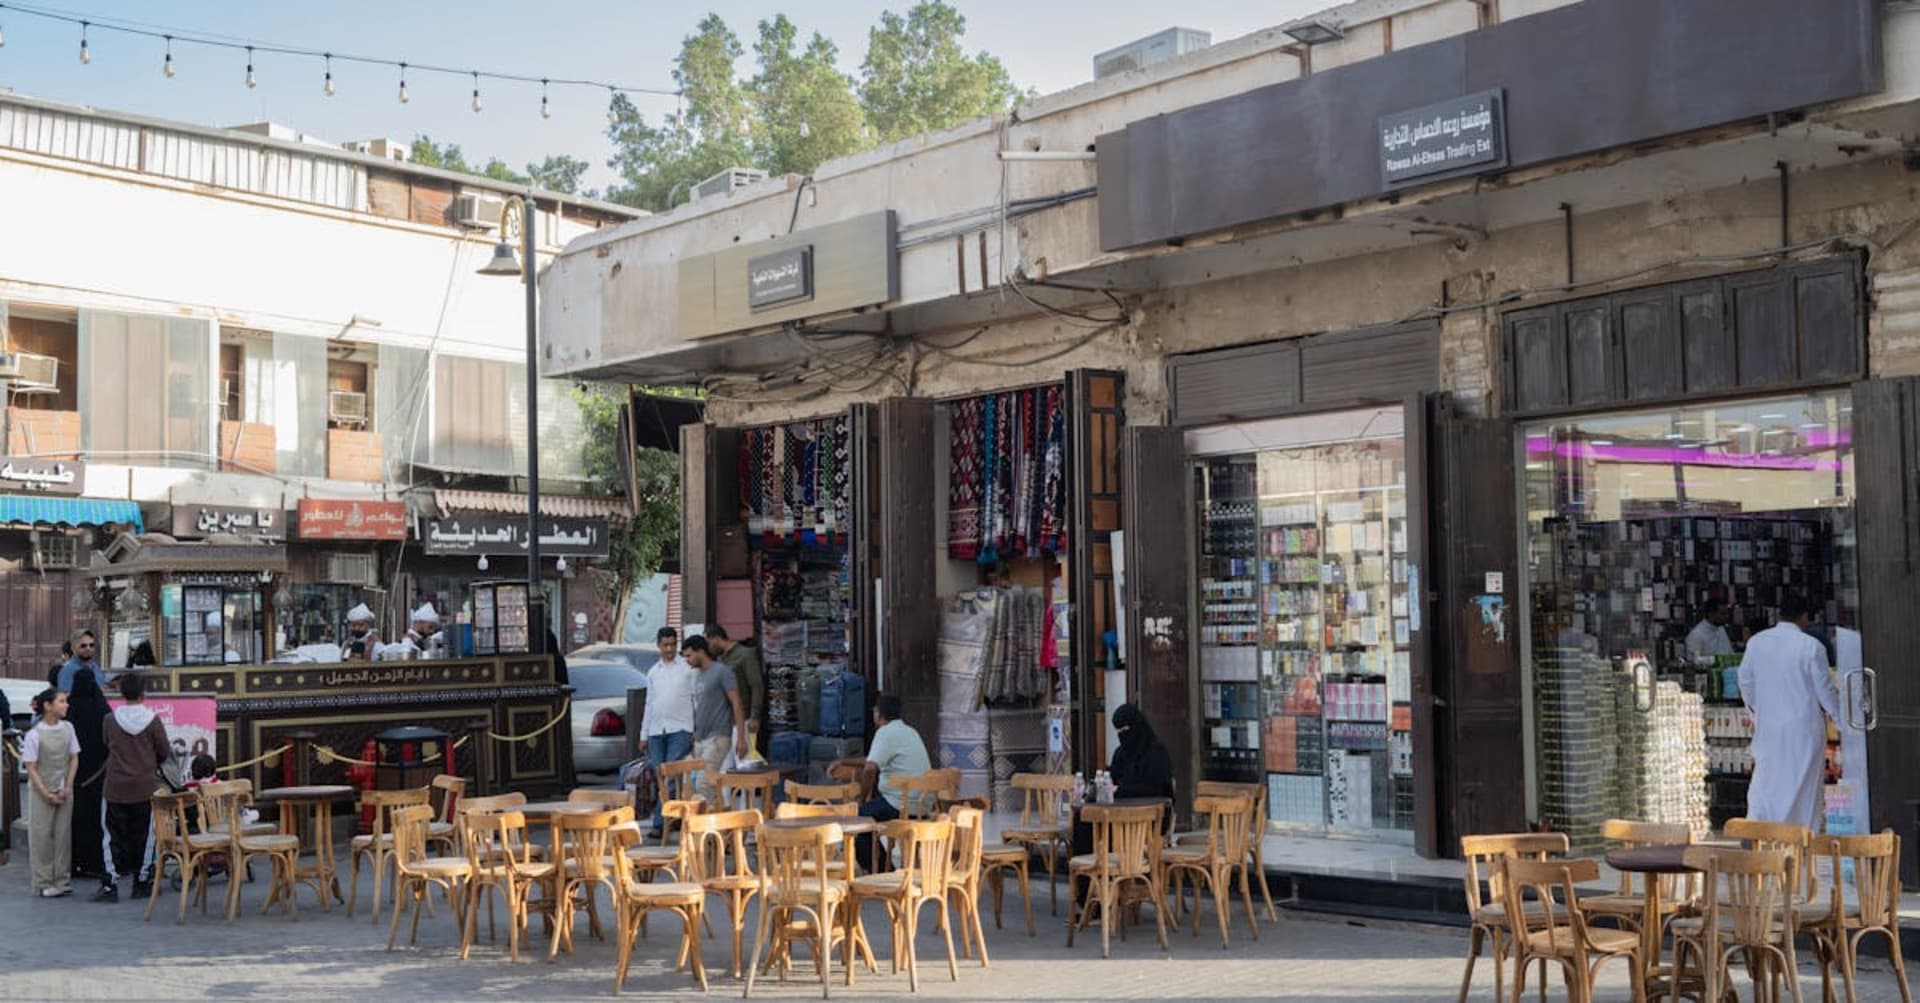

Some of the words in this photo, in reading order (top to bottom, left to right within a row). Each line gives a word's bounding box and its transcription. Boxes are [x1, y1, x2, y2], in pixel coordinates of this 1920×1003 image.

[1461, 104, 1491, 131] مؤسسة
[1446, 143, 1476, 160] Trading
[430, 521, 517, 546] الحديثة
[326, 669, 369, 685] الجميل
